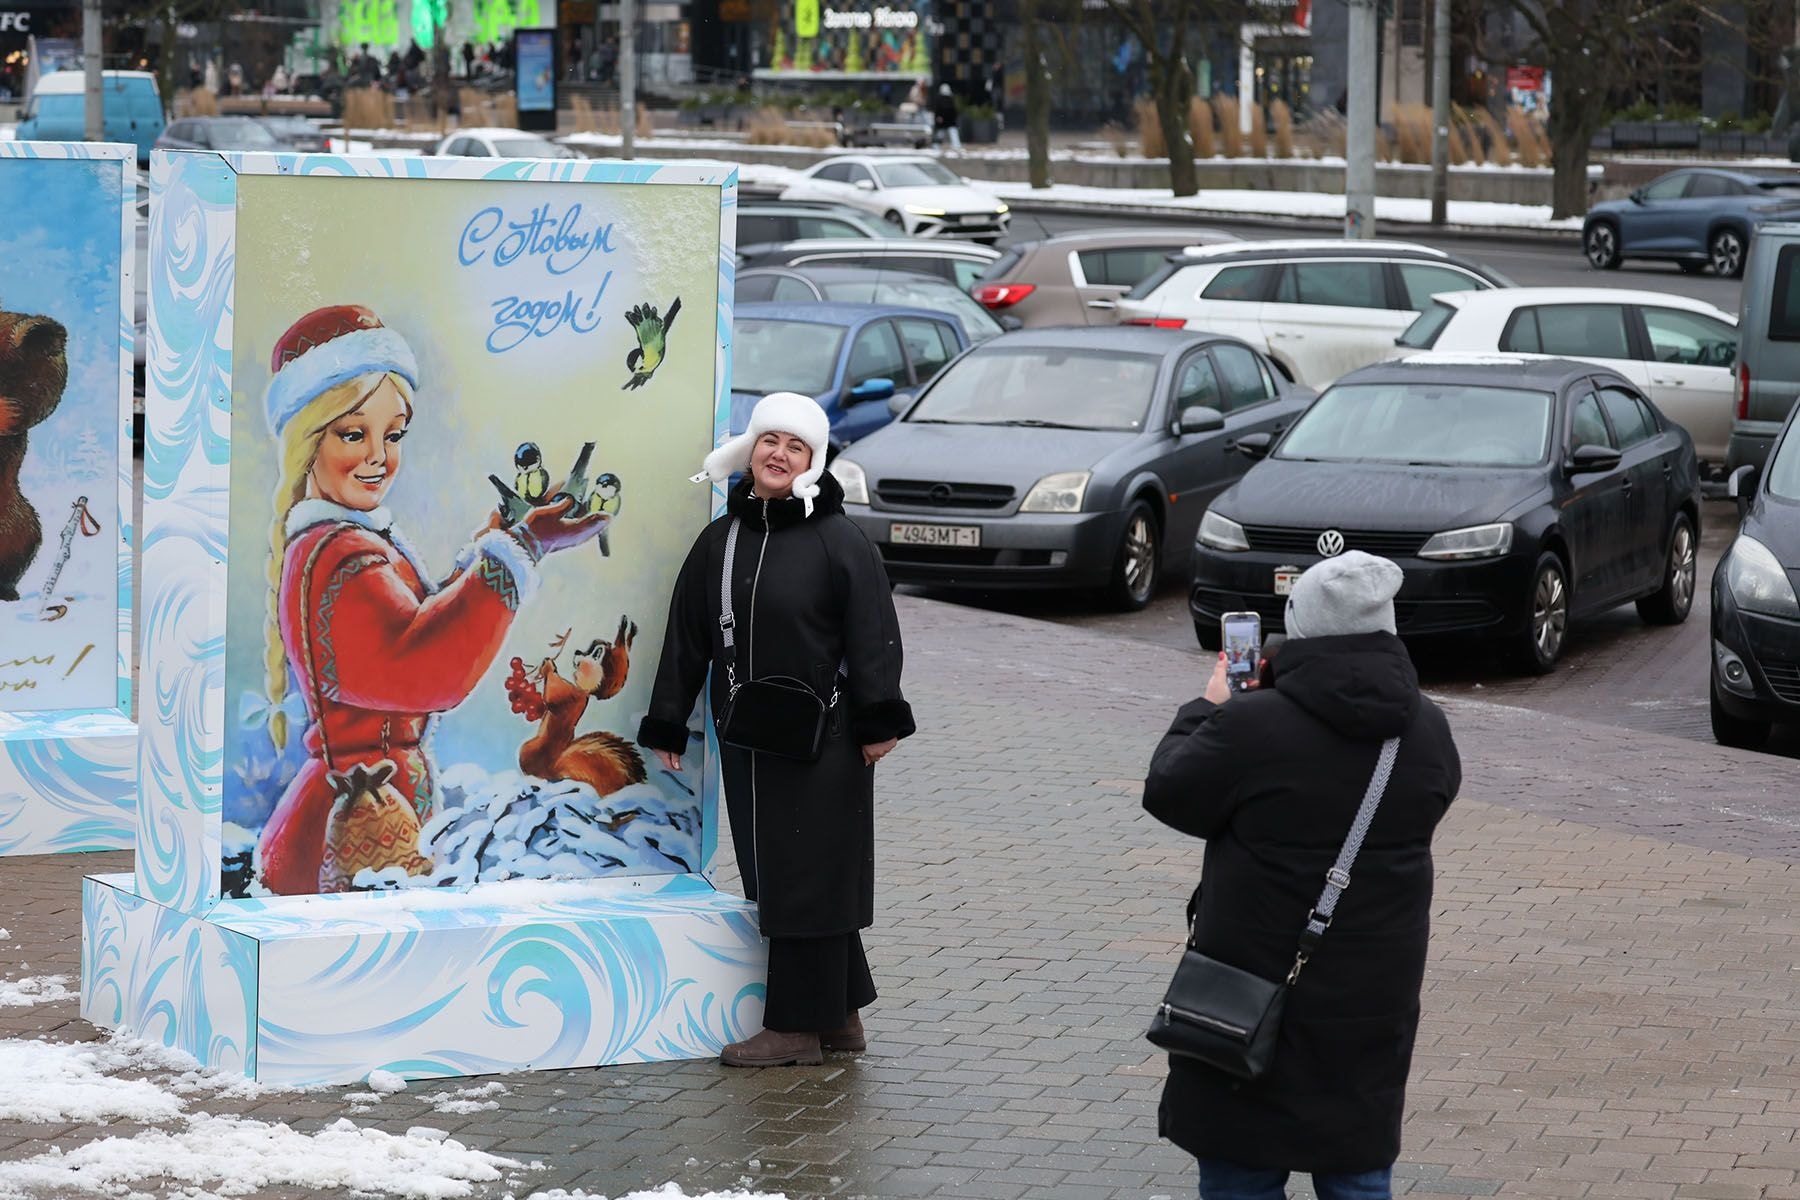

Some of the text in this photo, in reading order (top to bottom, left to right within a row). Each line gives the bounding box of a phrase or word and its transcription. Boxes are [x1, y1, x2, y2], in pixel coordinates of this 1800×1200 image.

[458, 202, 617, 275] С Новым
[486, 270, 613, 353] годом!
[903, 526, 977, 545] 4943MT-1
